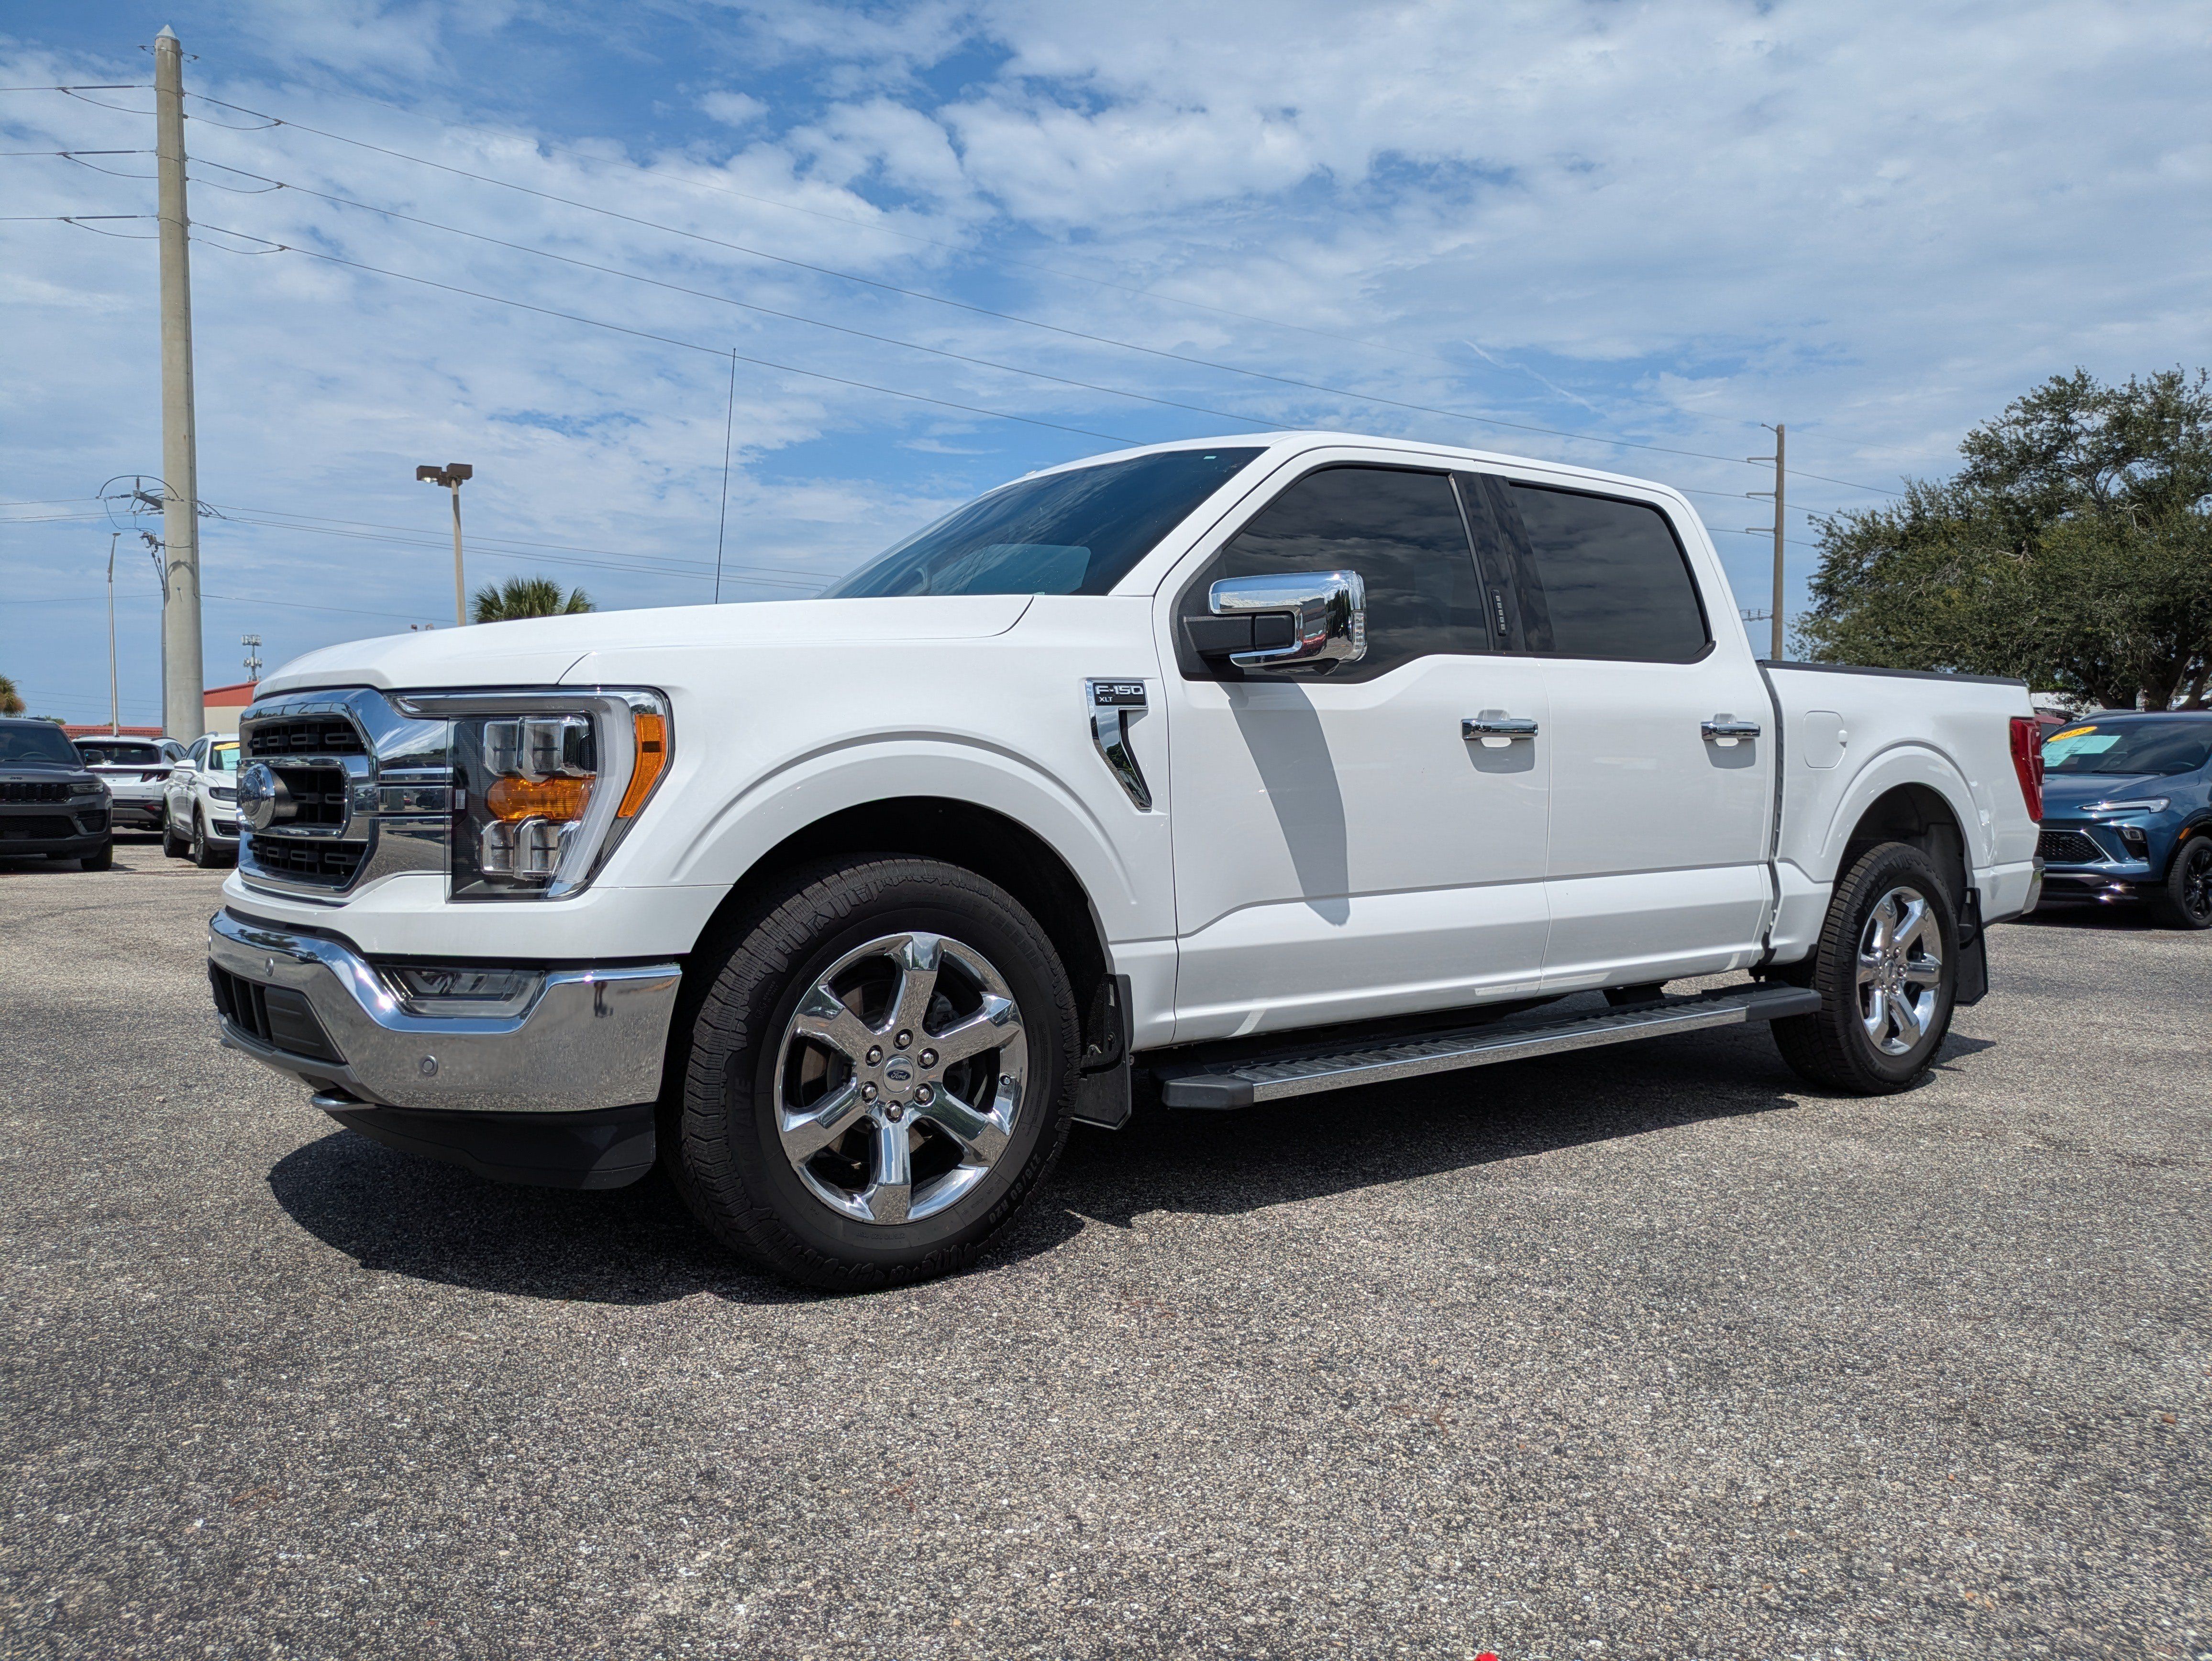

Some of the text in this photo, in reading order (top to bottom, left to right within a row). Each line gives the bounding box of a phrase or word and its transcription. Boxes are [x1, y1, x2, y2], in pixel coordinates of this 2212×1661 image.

[1095, 685, 1144, 695] F-150
[891, 1071, 907, 1080] Ford
[1010, 1153, 1041, 1201] 275/60
[989, 1199, 1009, 1224] R20
